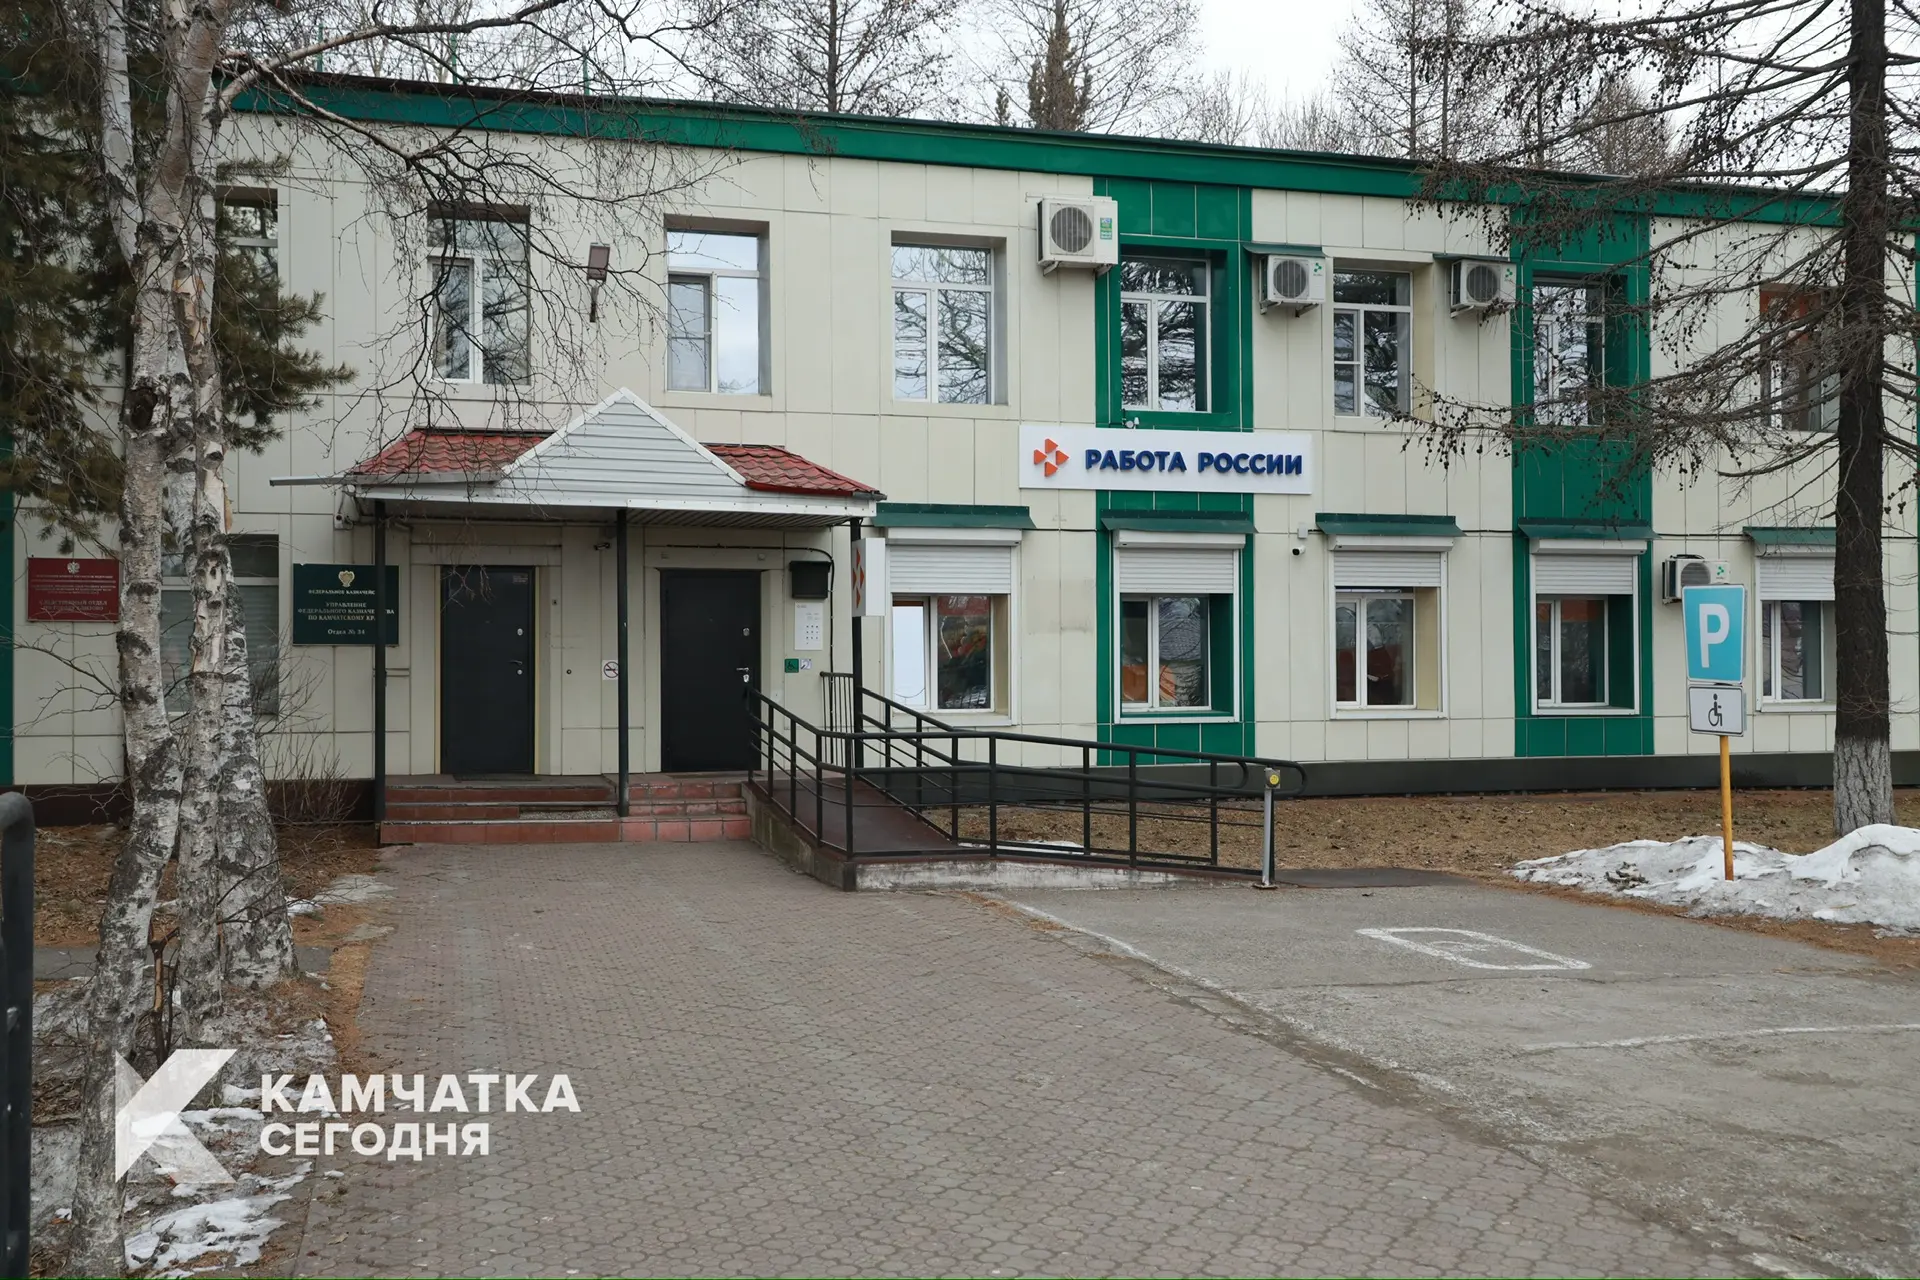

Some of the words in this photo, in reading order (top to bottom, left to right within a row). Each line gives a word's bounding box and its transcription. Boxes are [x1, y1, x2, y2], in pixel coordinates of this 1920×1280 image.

[1085, 449, 1188, 473] РАБОТА
[1198, 452, 1303, 475] РОССИИ
[1699, 603, 1730, 669] P
